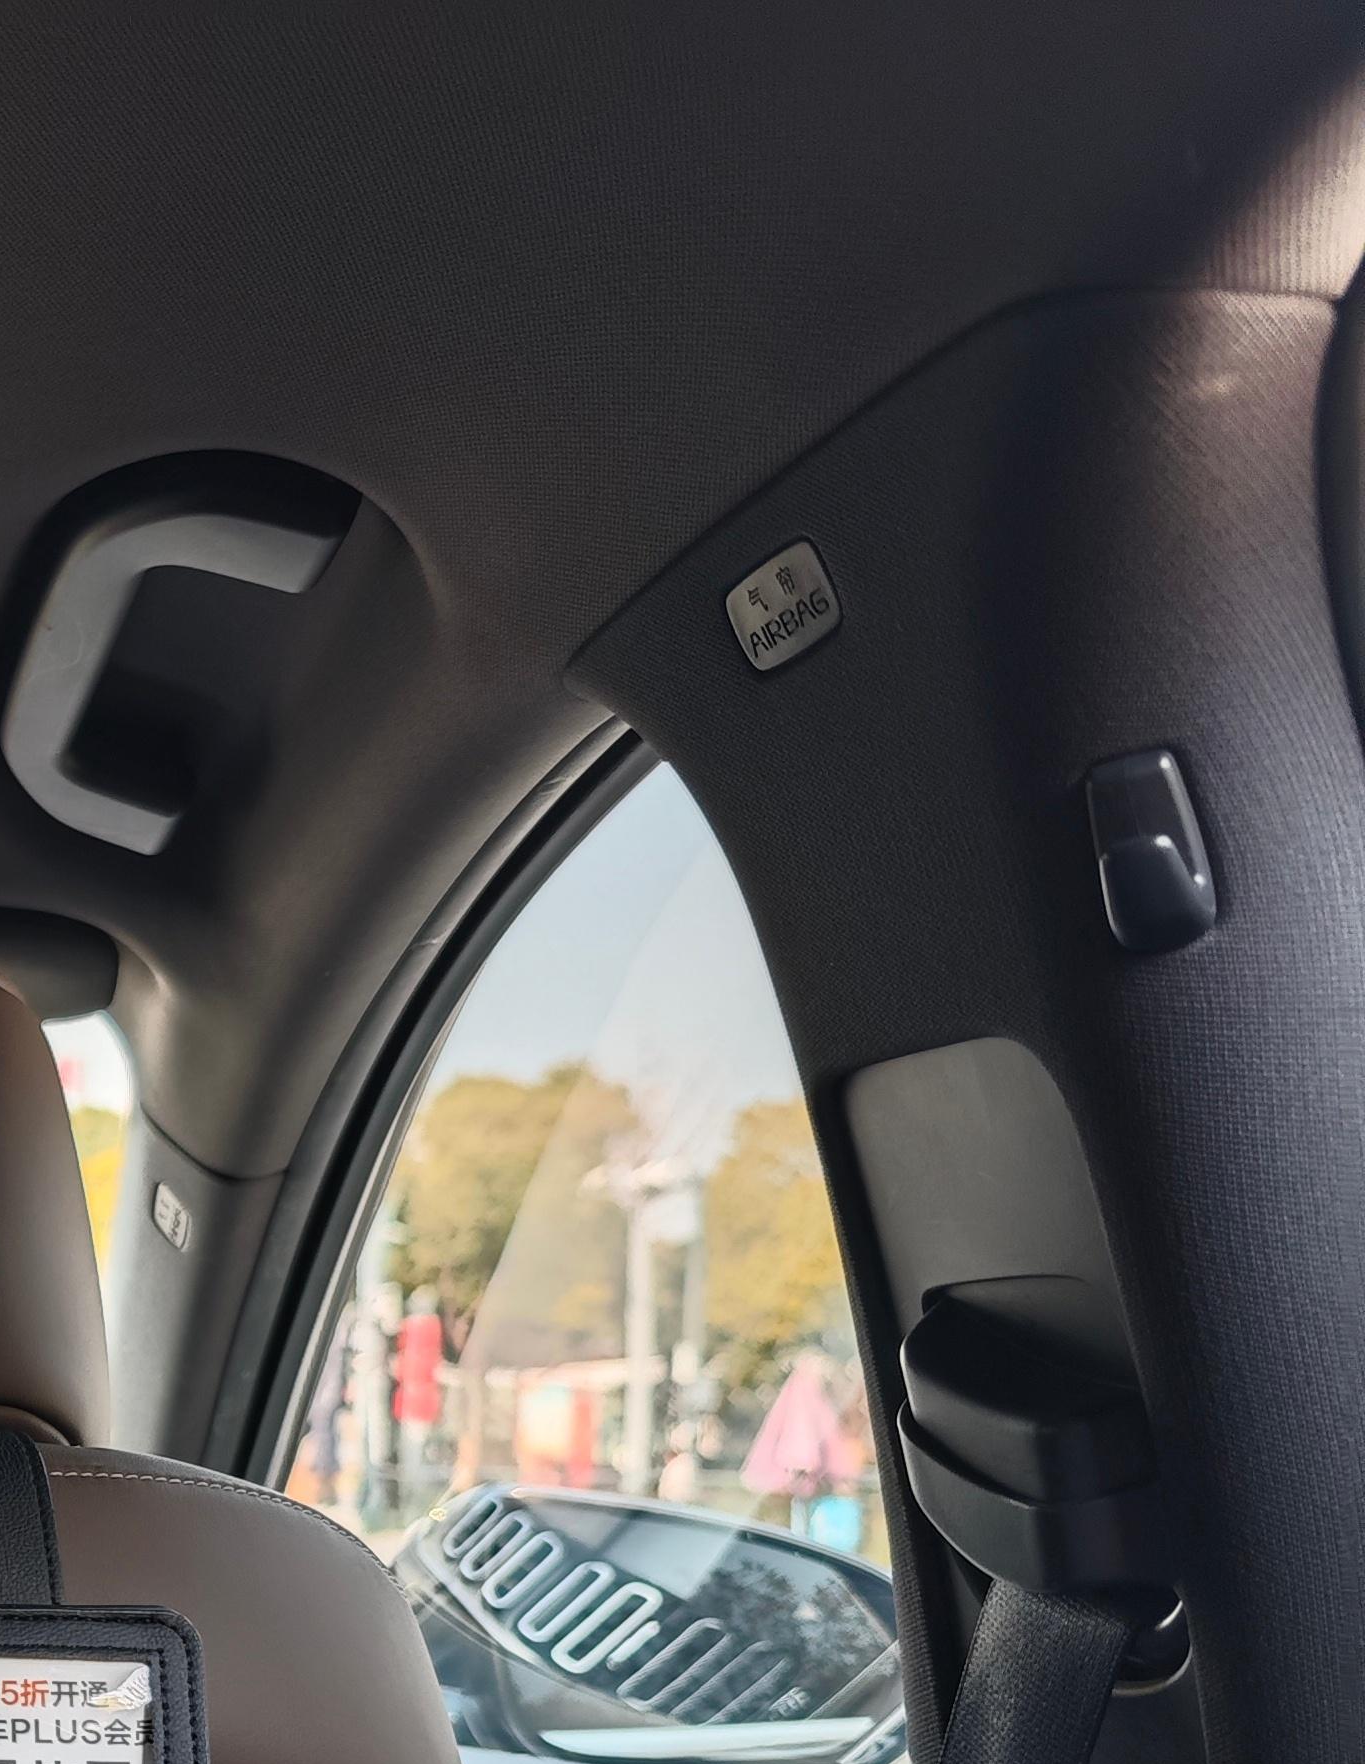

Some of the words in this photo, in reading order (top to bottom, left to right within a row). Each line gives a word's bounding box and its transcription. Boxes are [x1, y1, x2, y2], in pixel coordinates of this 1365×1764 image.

[749, 588, 830, 658] AIRBAG
[1, 1679, 110, 1708] 5折开通
